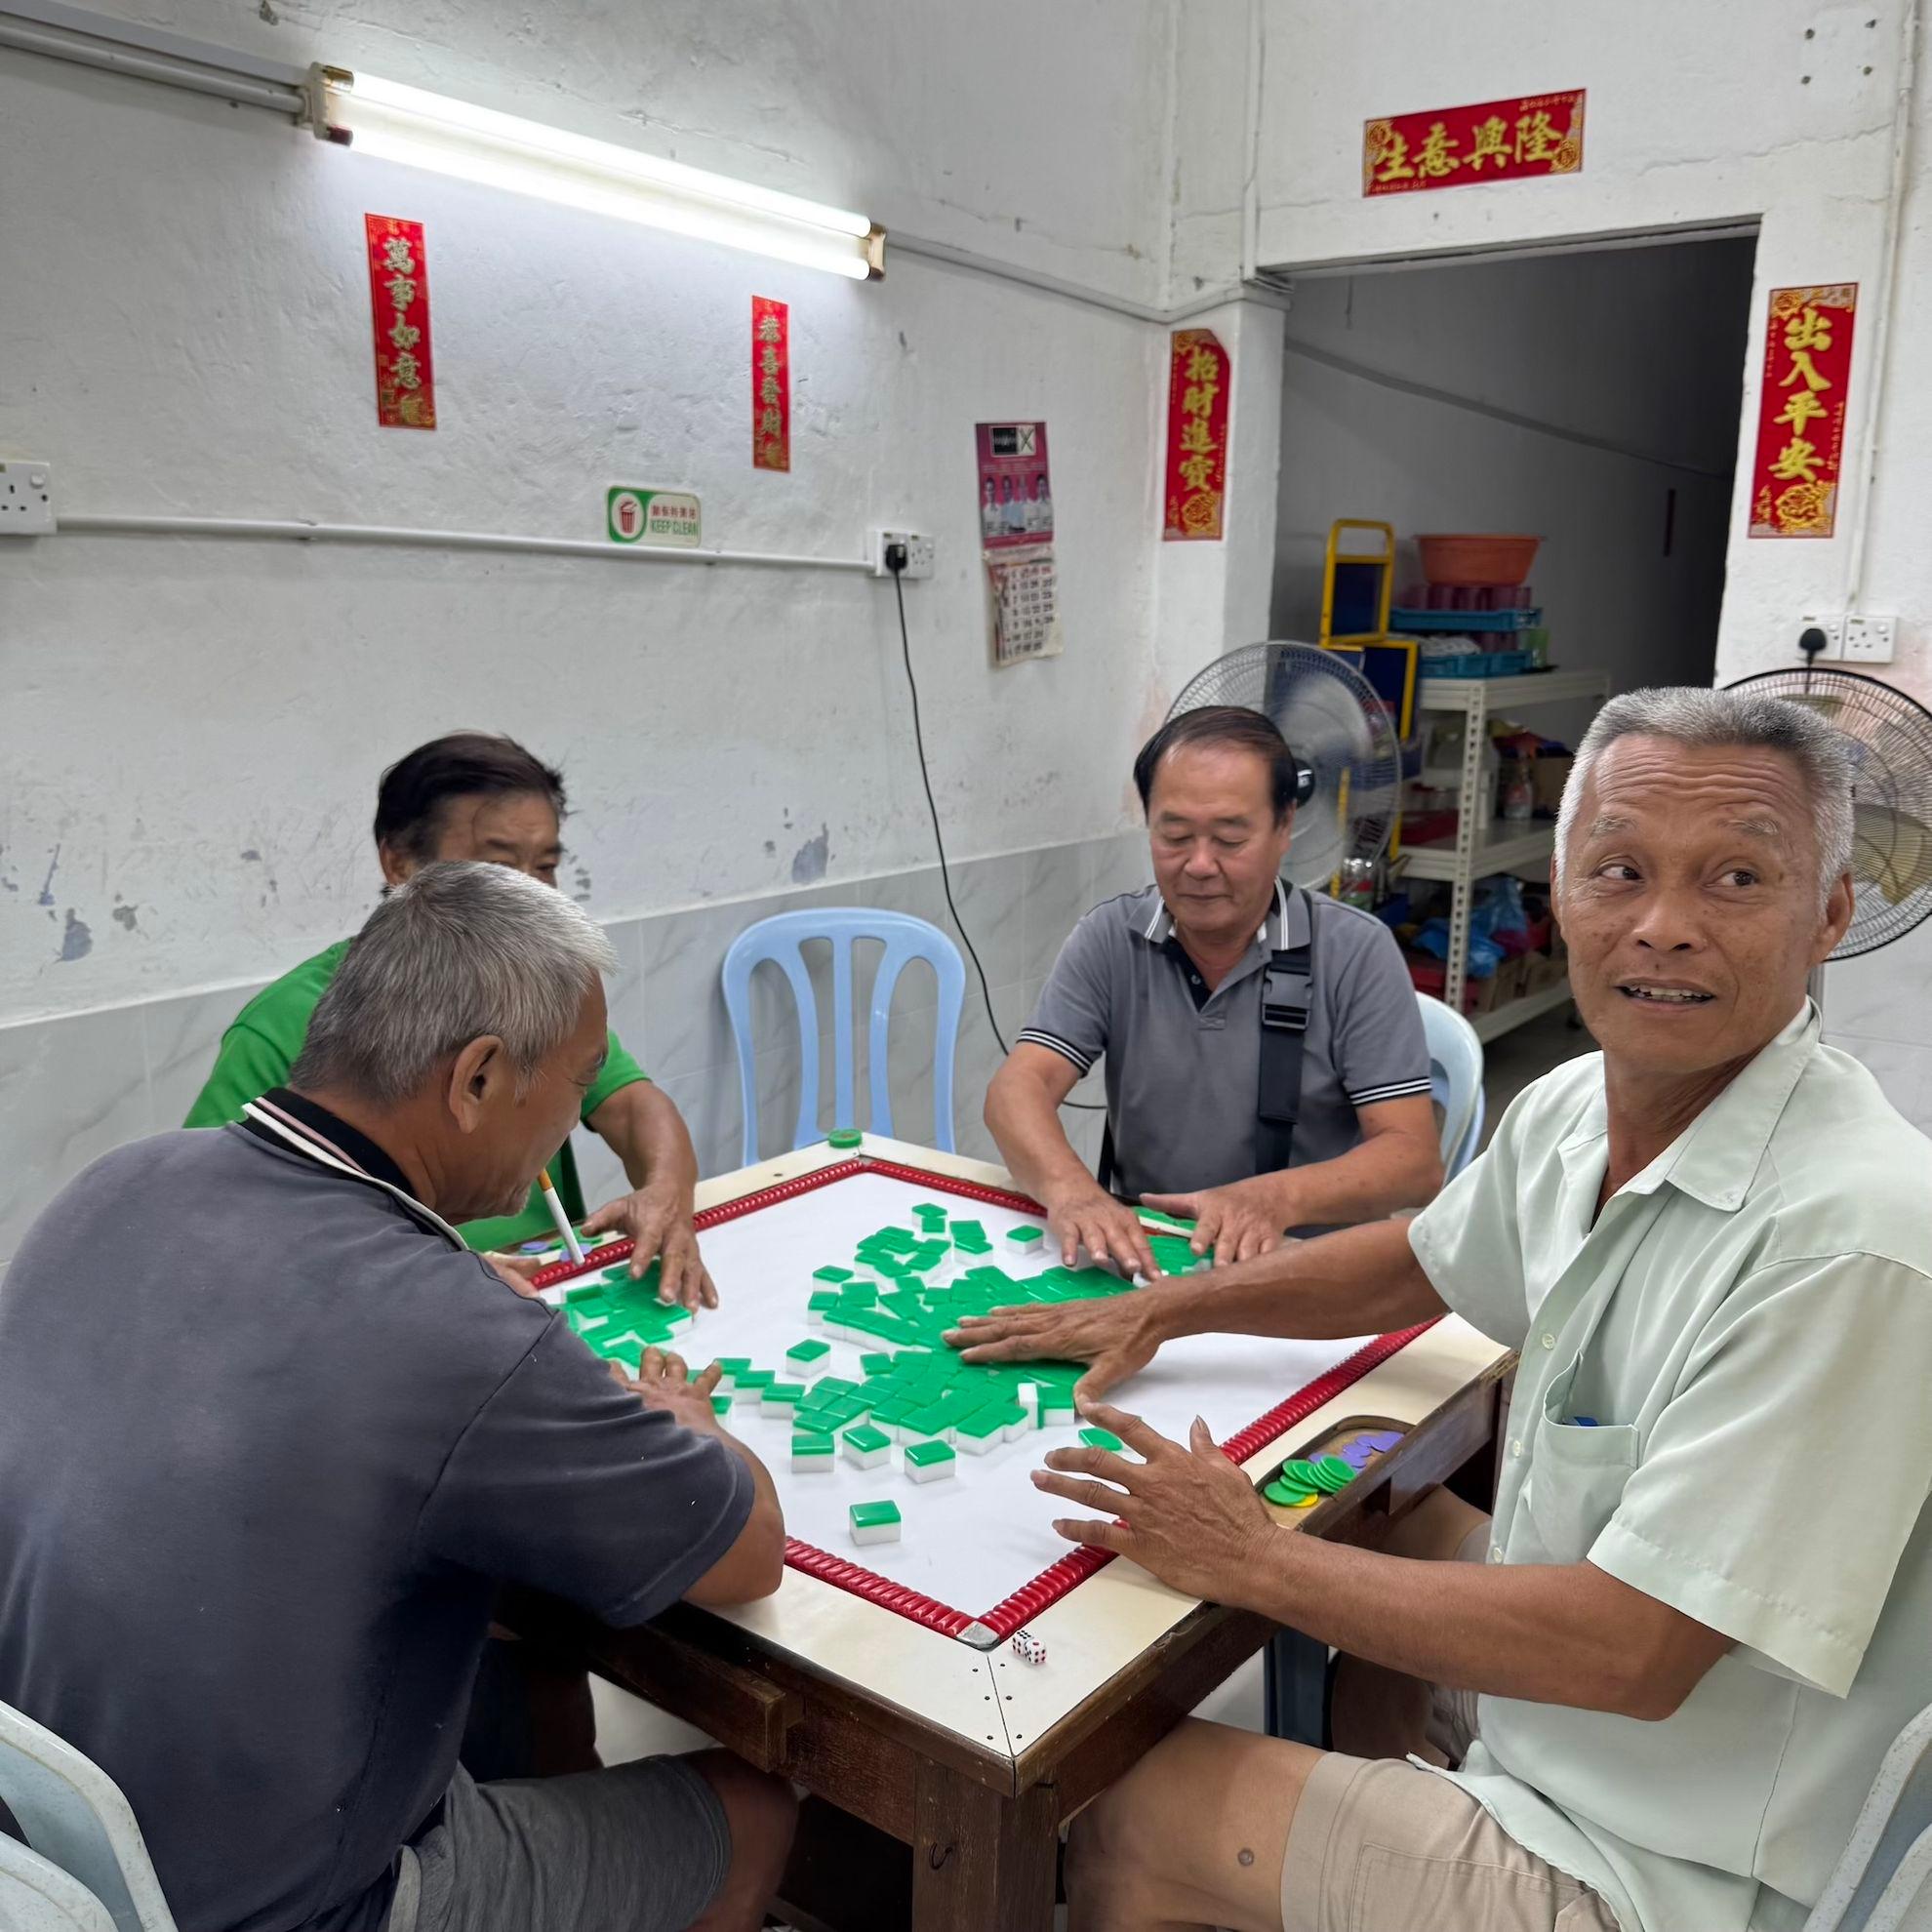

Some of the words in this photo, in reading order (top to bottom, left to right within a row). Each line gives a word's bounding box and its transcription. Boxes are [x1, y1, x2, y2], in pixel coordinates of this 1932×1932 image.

[1374, 110, 1563, 182] 生意興隆
[382, 236, 422, 390] 萬事如意
[1768, 306, 1832, 483] 出入平安
[651, 519, 671, 534] KEEP
[672, 521, 698, 536] CLEAN
